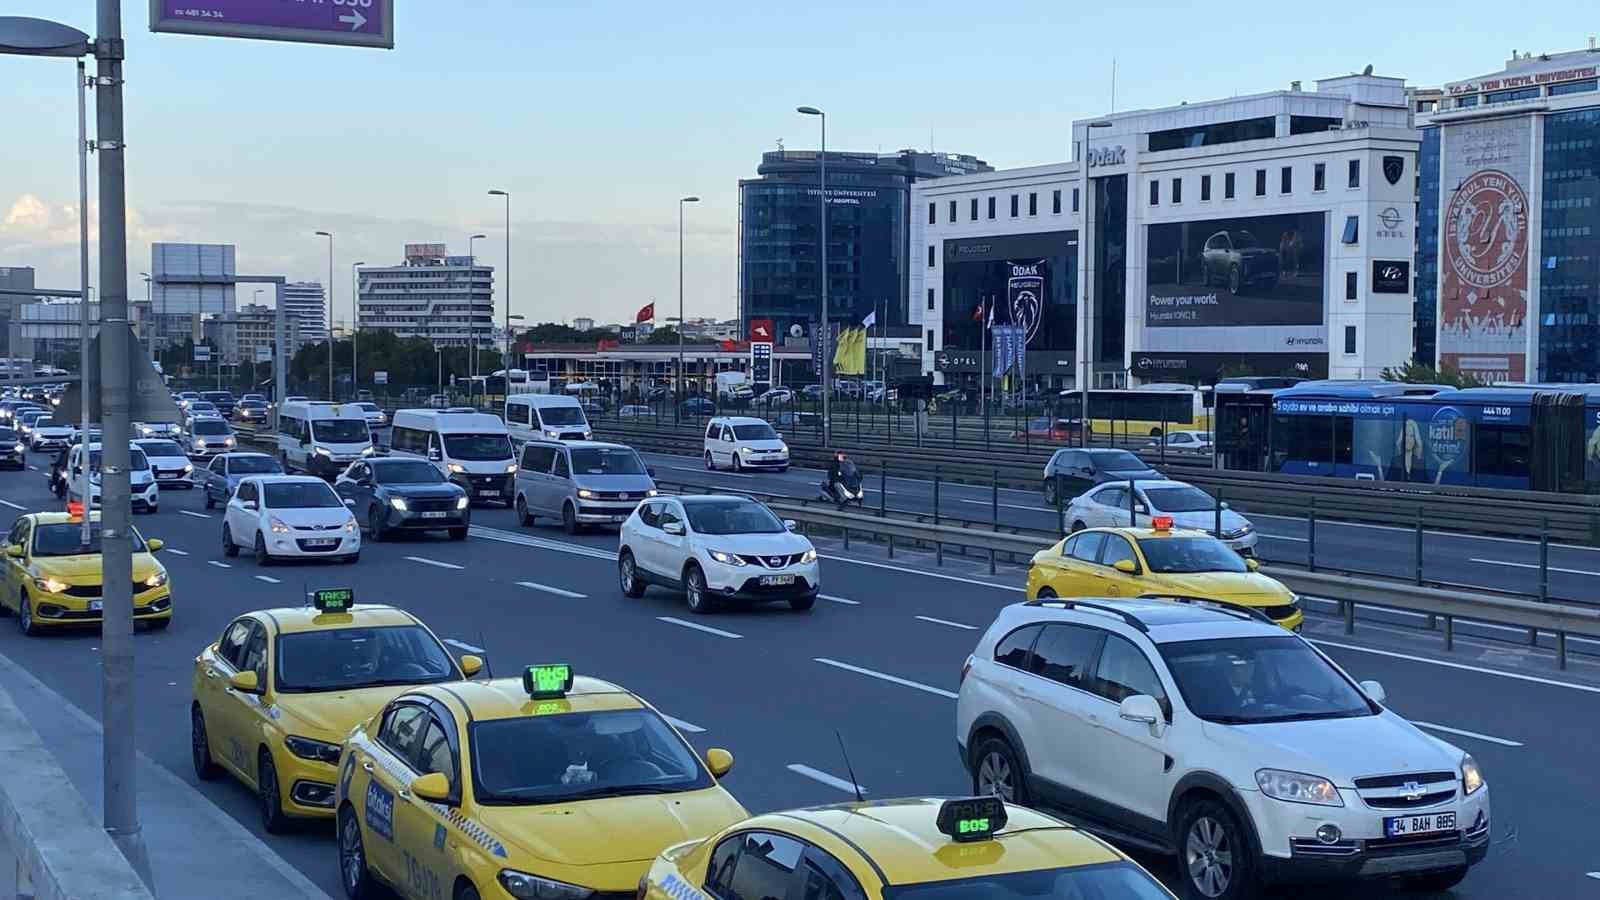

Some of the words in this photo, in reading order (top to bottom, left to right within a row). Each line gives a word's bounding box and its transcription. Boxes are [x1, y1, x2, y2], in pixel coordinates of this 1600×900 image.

[1151, 295, 1174, 305] Power
[1175, 297, 1193, 307] your
[1194, 294, 1219, 305] world.
[1393, 819, 1406, 833] 34
[1412, 816, 1431, 832] BAH
[1436, 815, 1454, 830] 885
